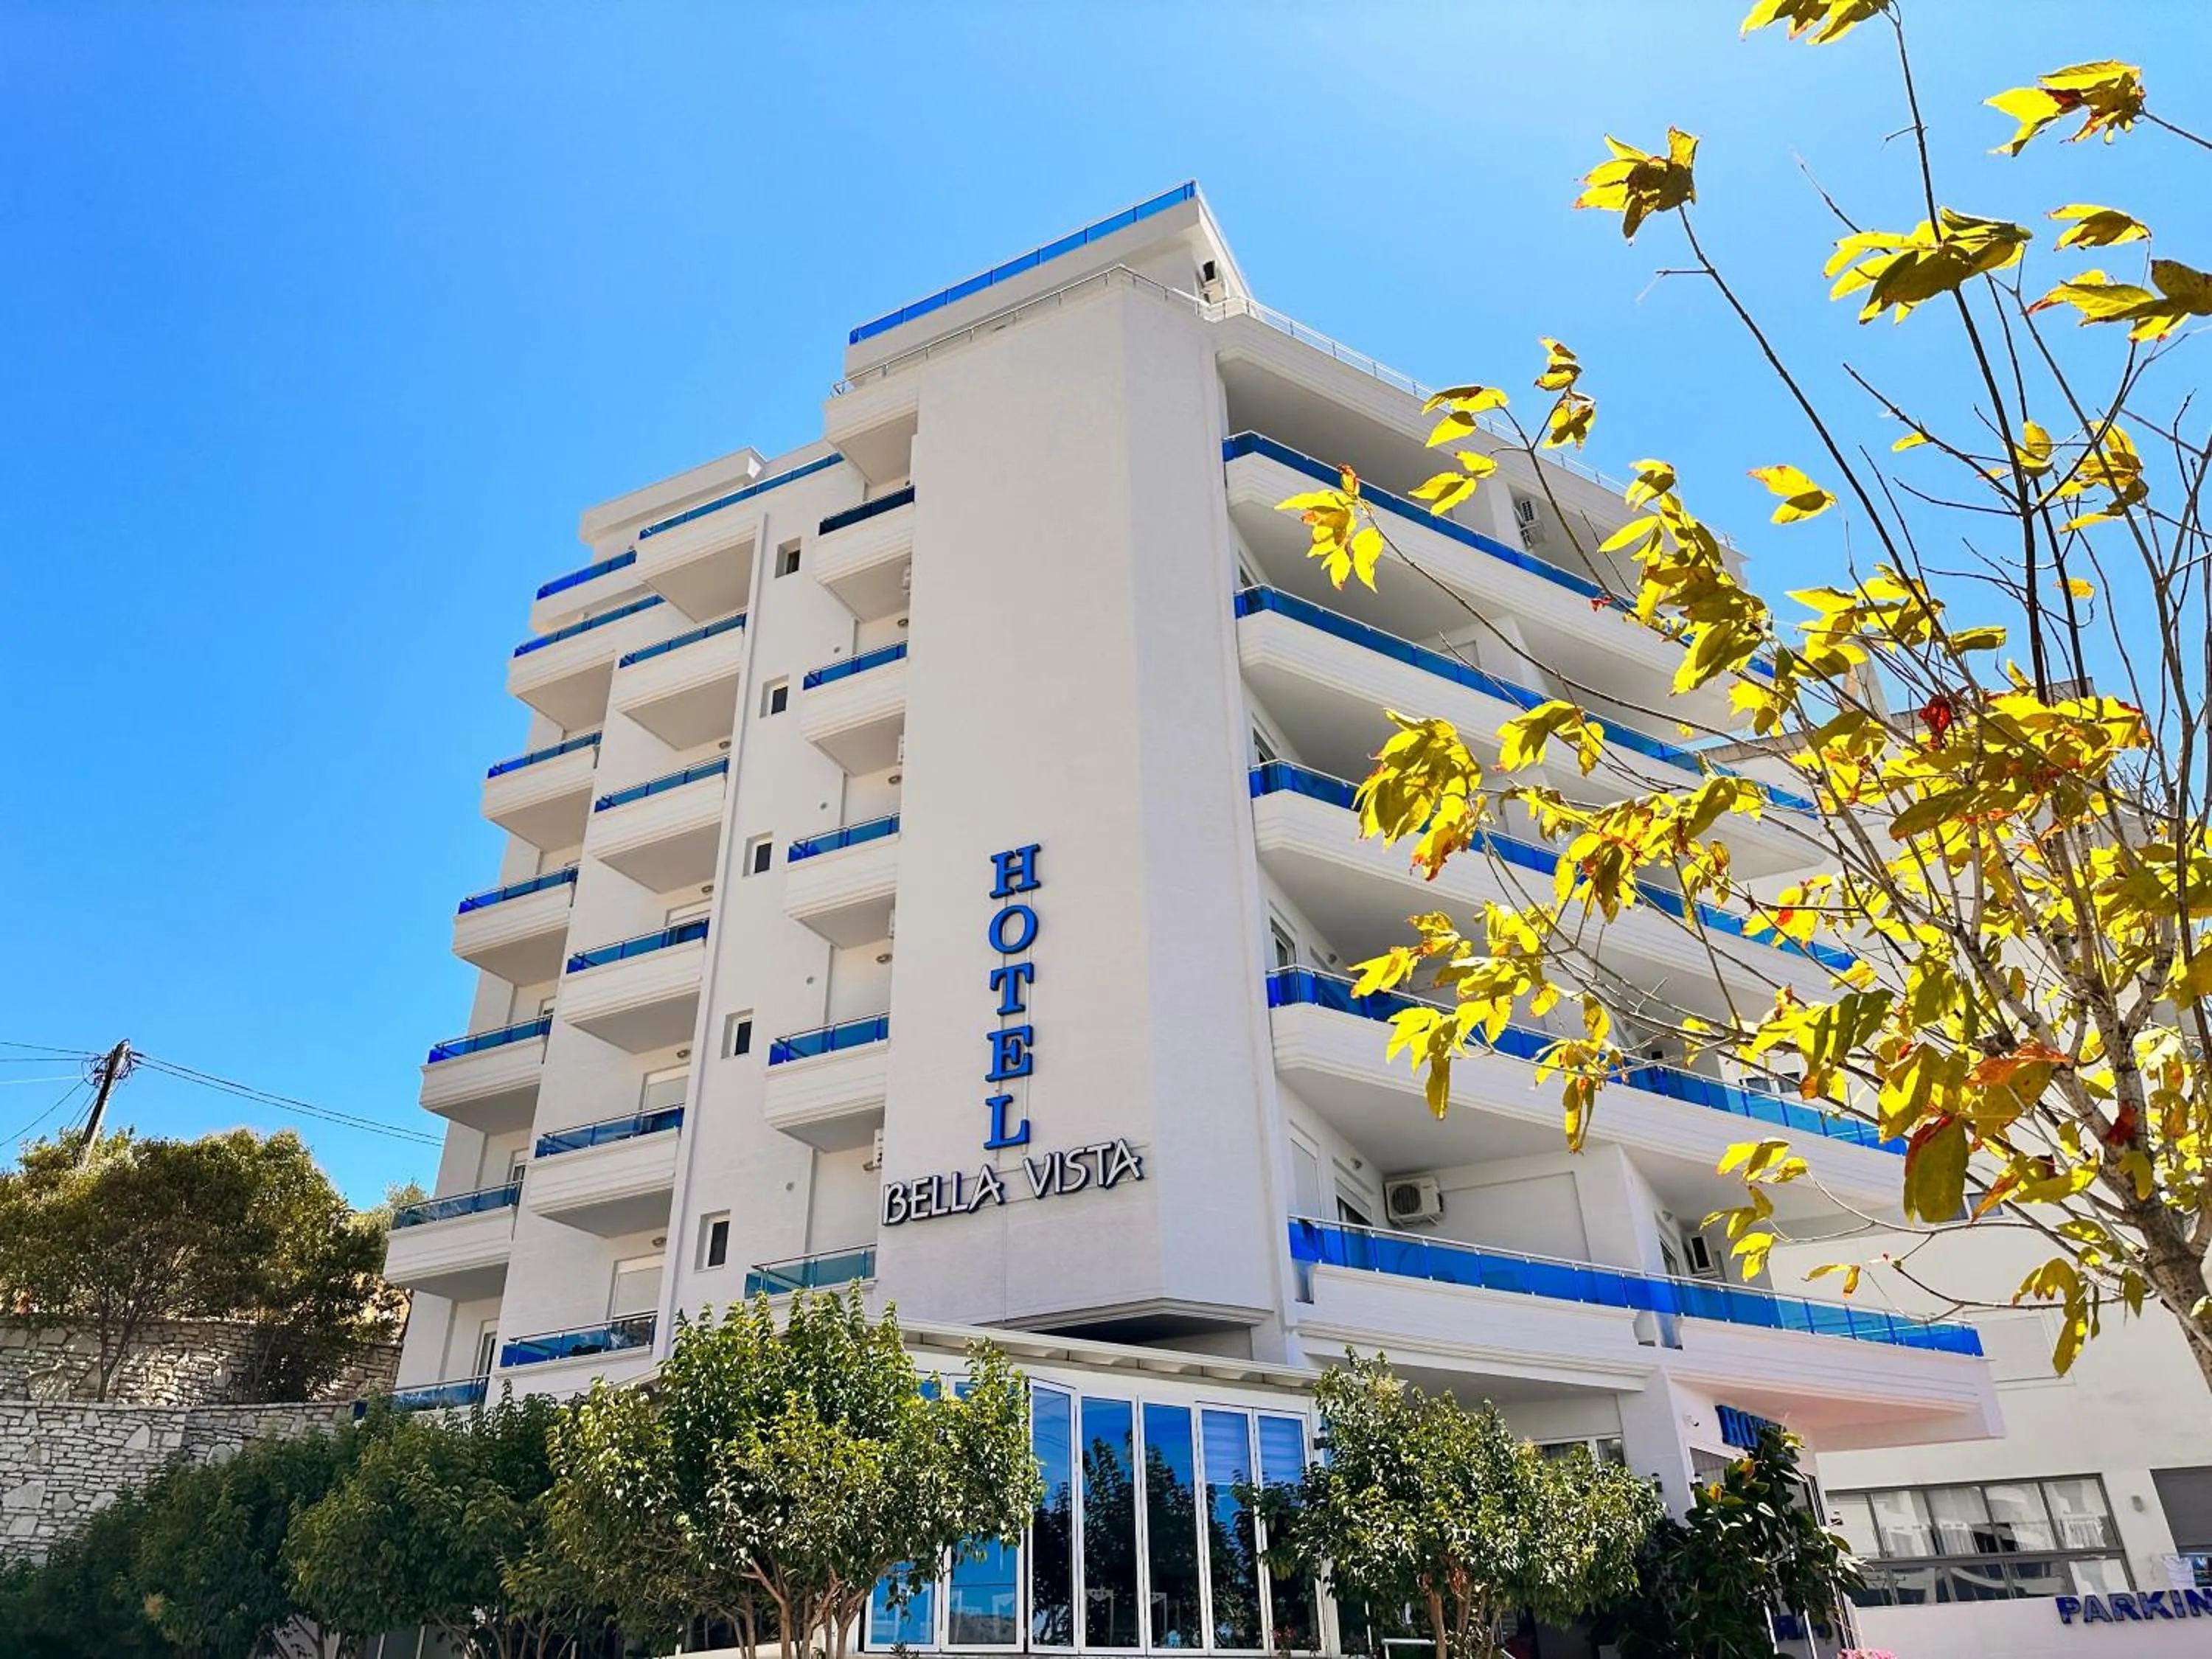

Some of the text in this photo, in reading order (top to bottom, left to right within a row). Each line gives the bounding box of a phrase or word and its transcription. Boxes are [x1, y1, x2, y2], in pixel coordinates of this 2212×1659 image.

[984, 844, 1041, 1150] HOTEL
[882, 1138, 1145, 1226] BELLA VISTA
